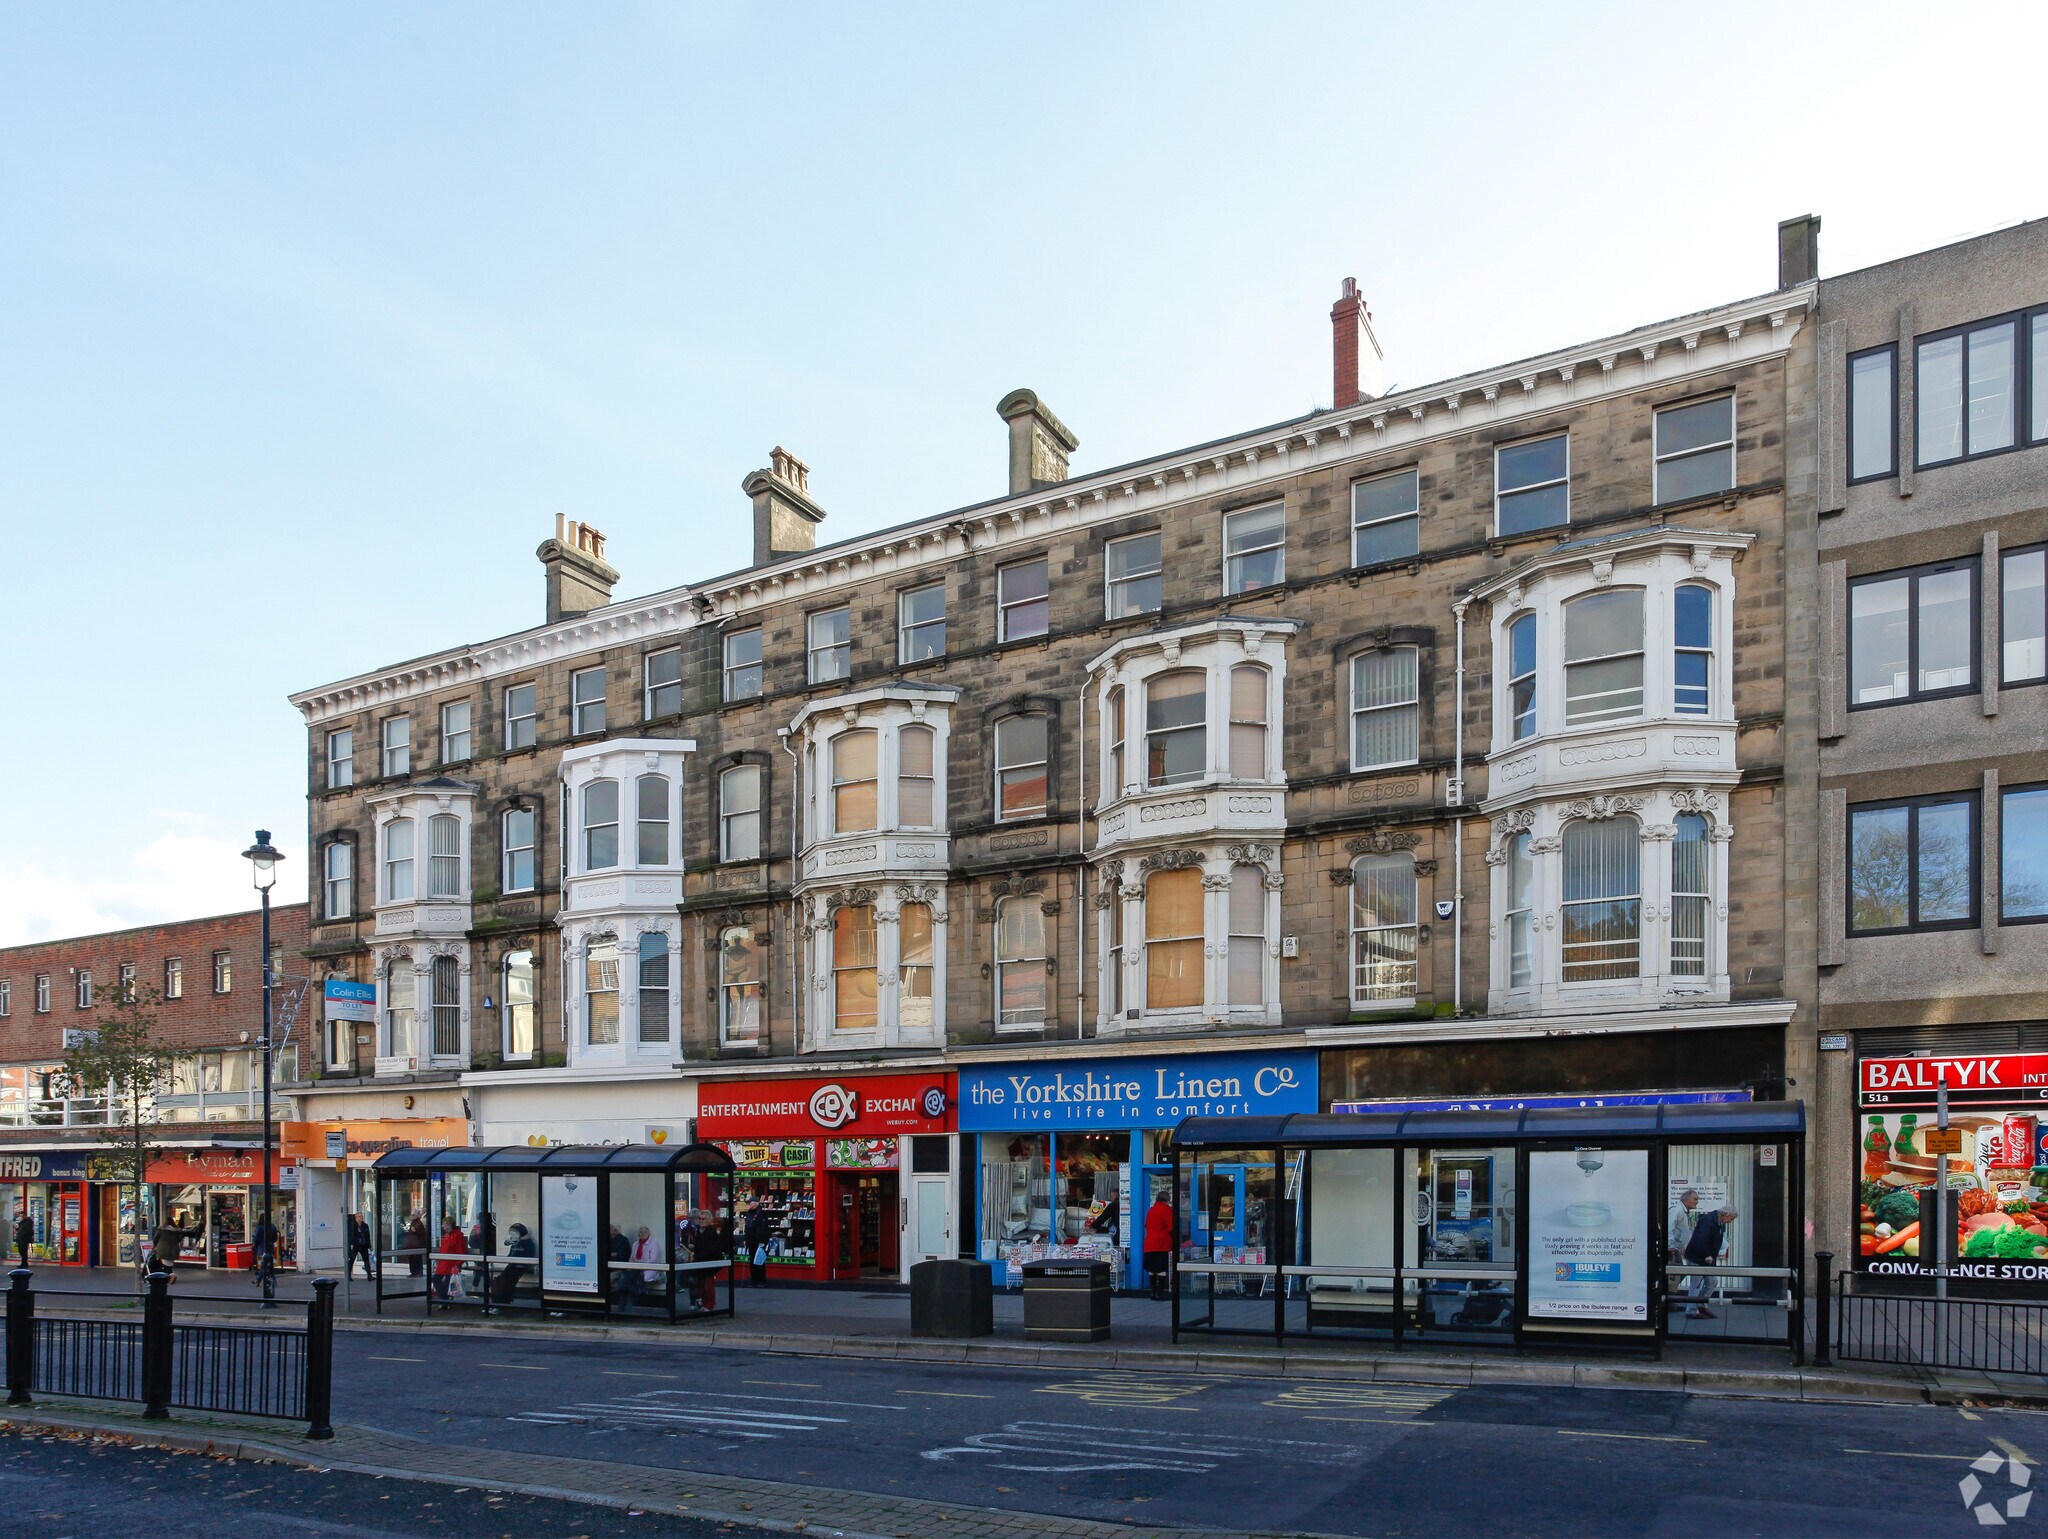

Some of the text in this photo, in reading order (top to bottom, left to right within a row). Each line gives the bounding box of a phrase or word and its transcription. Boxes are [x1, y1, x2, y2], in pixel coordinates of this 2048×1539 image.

[332, 988, 372, 998] Colin Ellis
[1869, 1060, 2001, 1088] BALTYK
[971, 1080, 1005, 1105] the
[1008, 1071, 1141, 1104] Yorkshire
[1154, 1069, 1242, 1101] Linen
[1868, 1094, 1889, 1102] 51a
[701, 1101, 806, 1117] ENTERTAINMENT
[865, 1097, 916, 1113] EXCHA
[1013, 1102, 1250, 1119] live life in comfort
[744, 1149, 765, 1161] STUFF
[786, 1149, 809, 1162] CASH
[52, 1168, 85, 1178] bonus king
[1575, 1264, 1610, 1272] IBULEVE
